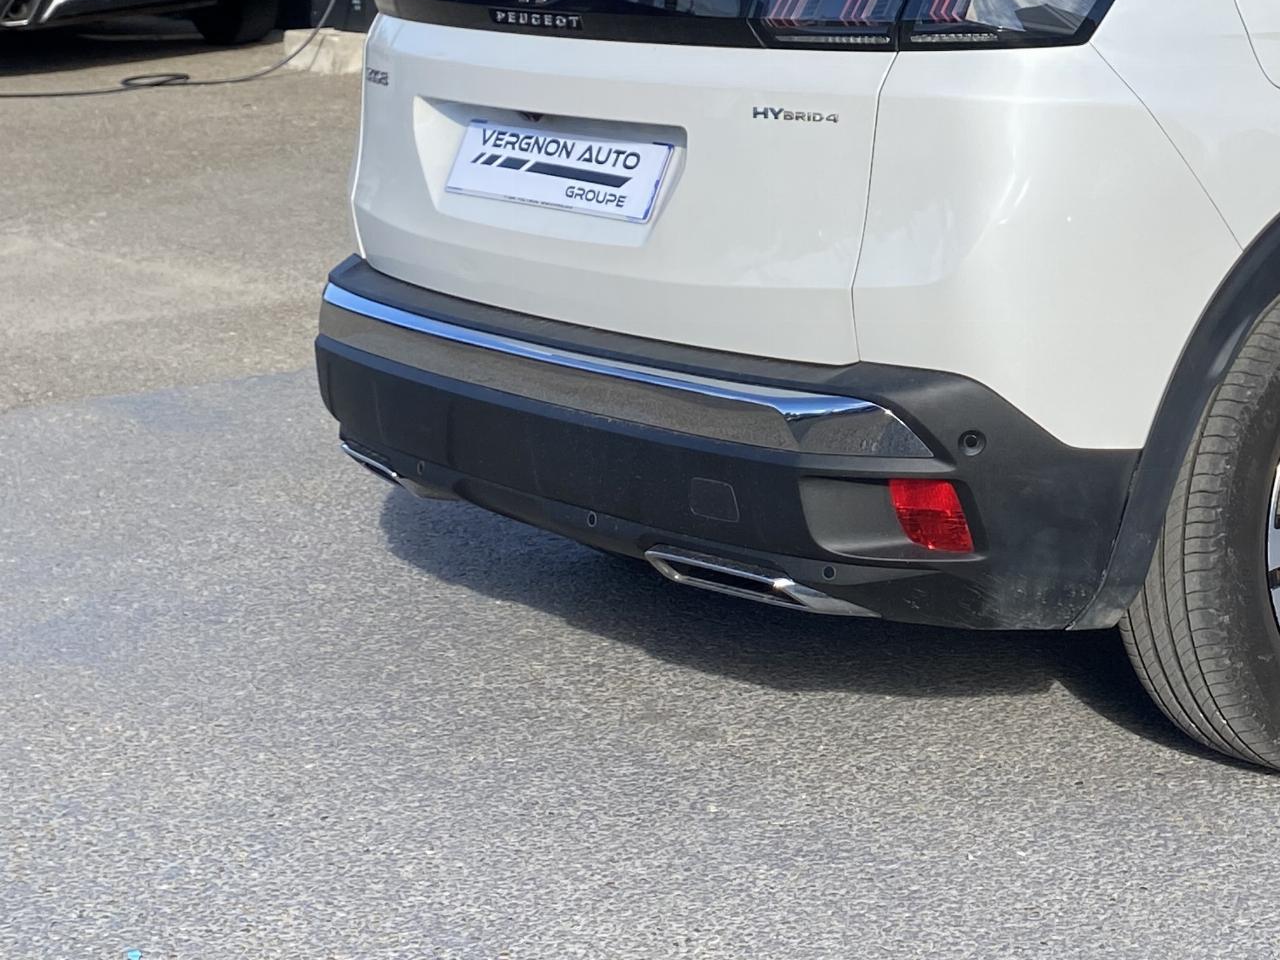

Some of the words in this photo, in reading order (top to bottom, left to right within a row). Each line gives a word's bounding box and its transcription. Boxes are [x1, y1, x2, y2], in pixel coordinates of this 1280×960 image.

[496, 10, 579, 28] PEUGEOT
[481, 128, 576, 160] VERGNON
[576, 145, 641, 170] AUTO
[565, 185, 628, 209] GROUPE
